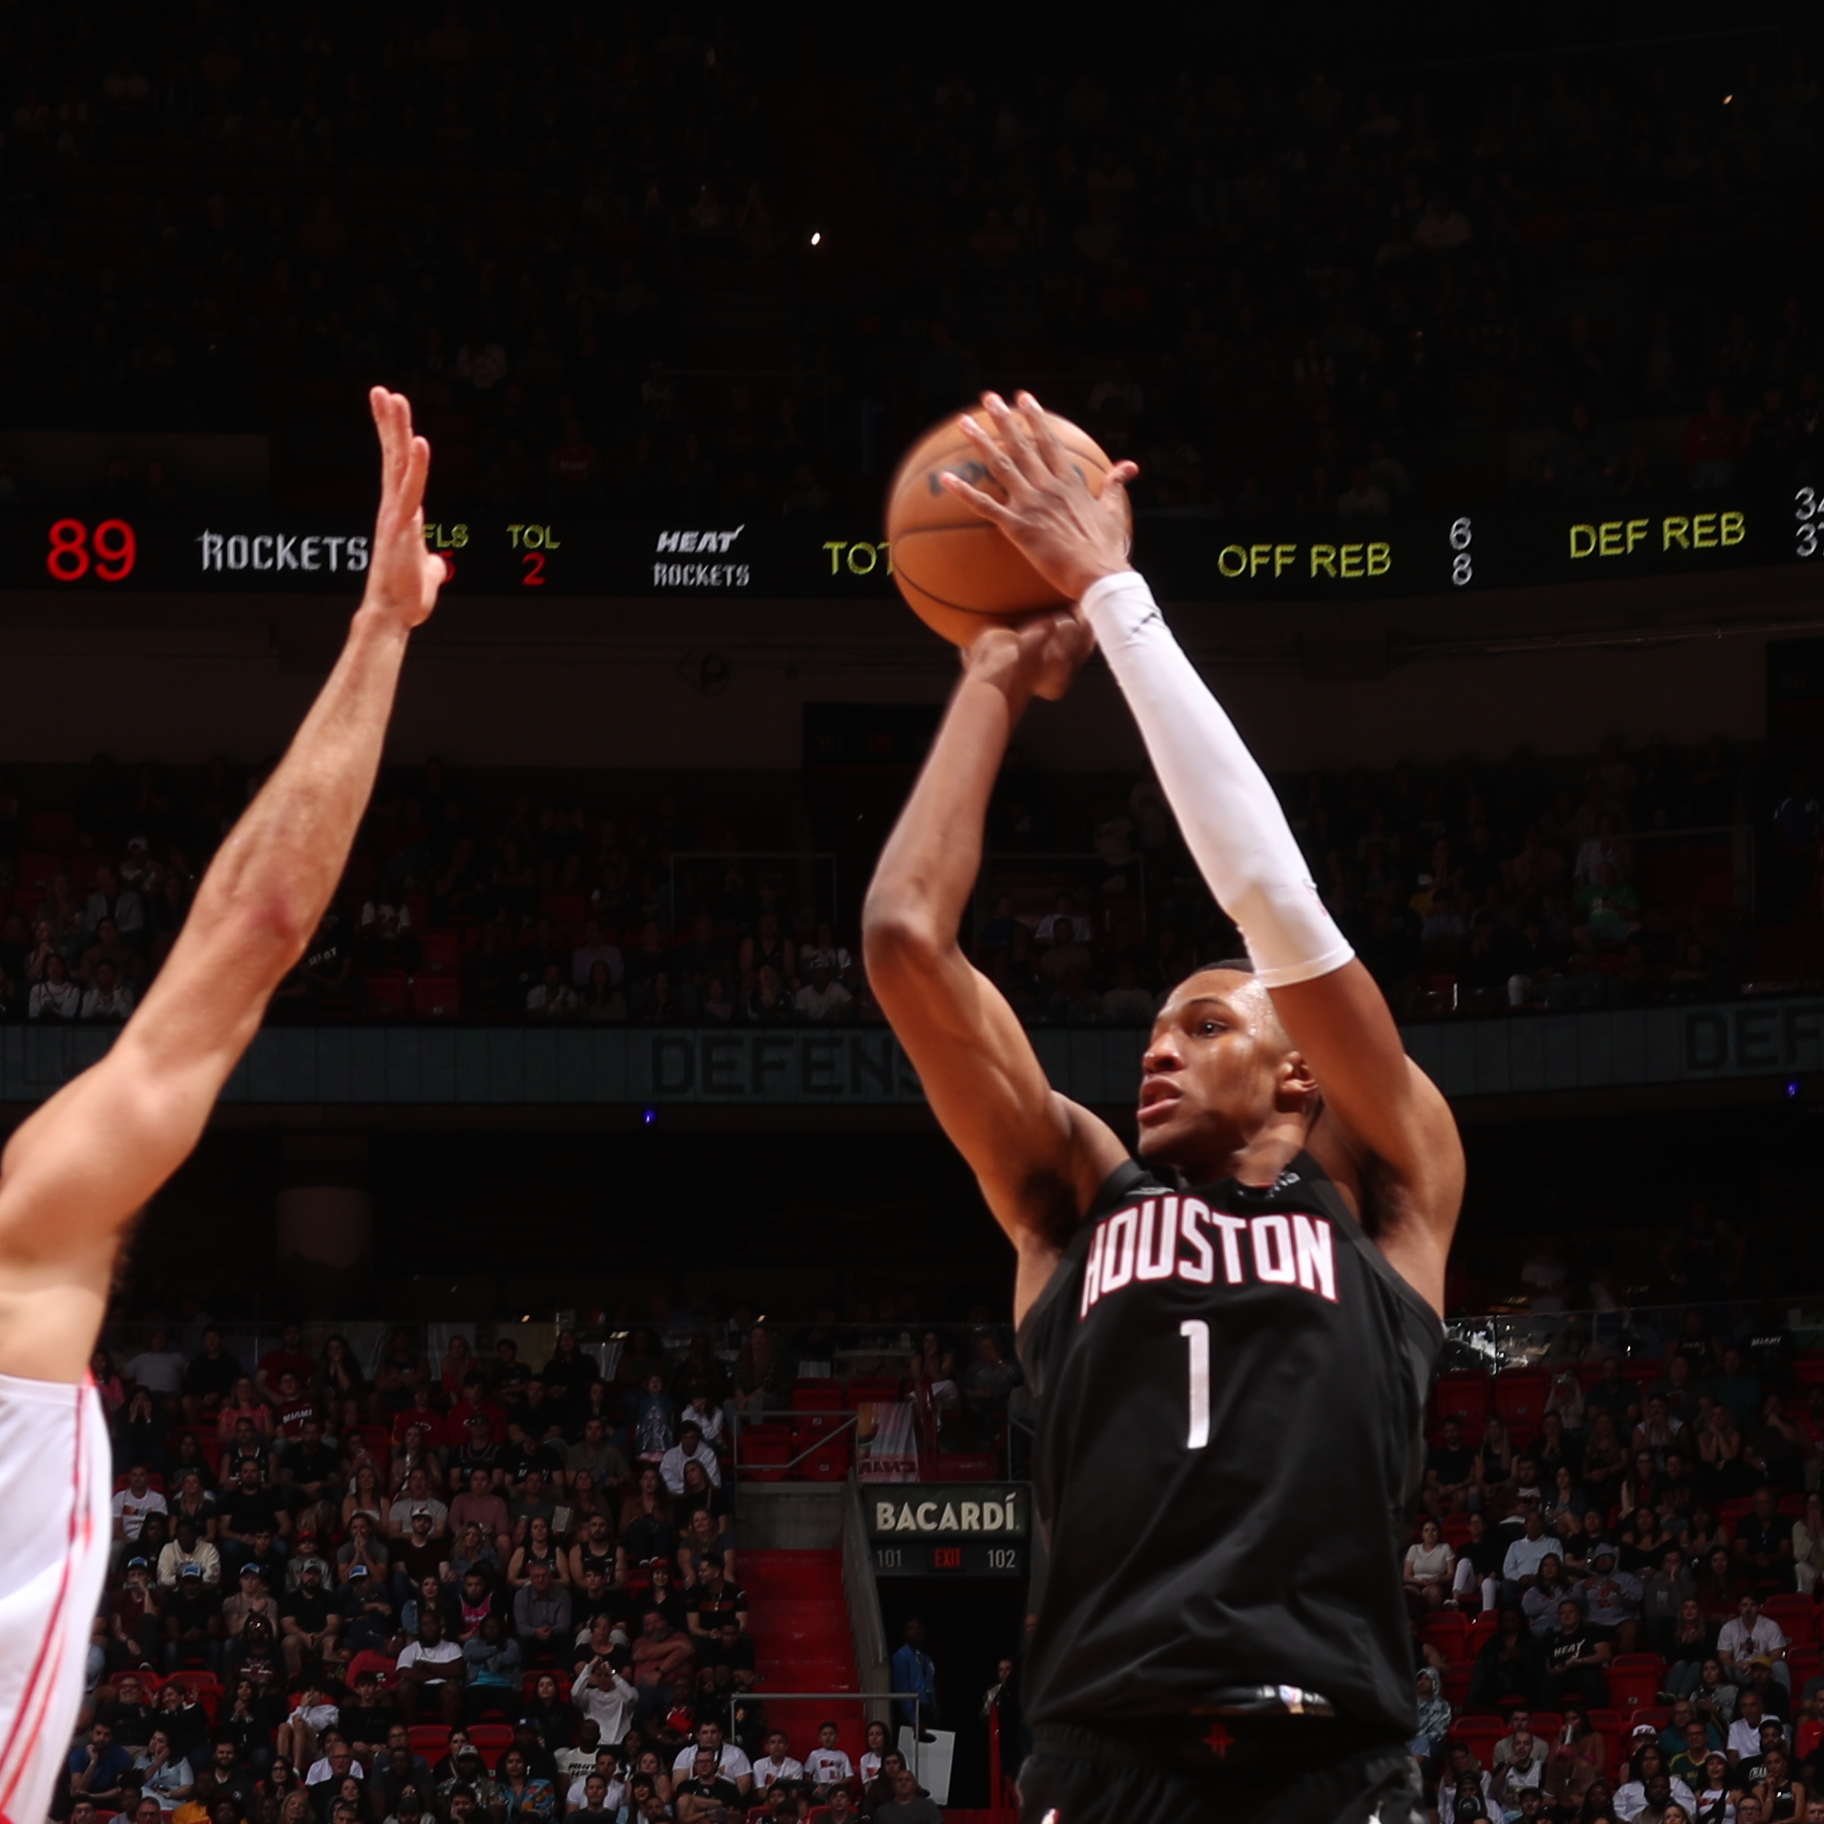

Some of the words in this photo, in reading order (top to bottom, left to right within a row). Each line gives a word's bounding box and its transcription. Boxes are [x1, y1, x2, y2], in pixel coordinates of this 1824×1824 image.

[46, 518, 137, 582] 89
[198, 528, 369, 572] ROCKETS
[506, 524, 561, 550] TOL
[656, 524, 745, 553] HEAT
[1449, 517, 1472, 551] 6
[1569, 518, 1649, 559] DEF
[1662, 511, 1746, 551] REB
[522, 552, 546, 586] 2
[653, 560, 750, 587] ROCKETS
[1217, 544, 1297, 578] OFF
[1310, 542, 1392, 578] REB
[1451, 553, 1473, 586] 8
[1078, 1194, 1340, 1321] HOUSTON
[1179, 1319, 1211, 1451] 1
[876, 1492, 1017, 1532] BACARDÍ
[876, 1549, 903, 1570] 101
[934, 1547, 963, 1569] EXIT
[987, 1549, 1017, 1570] 102
